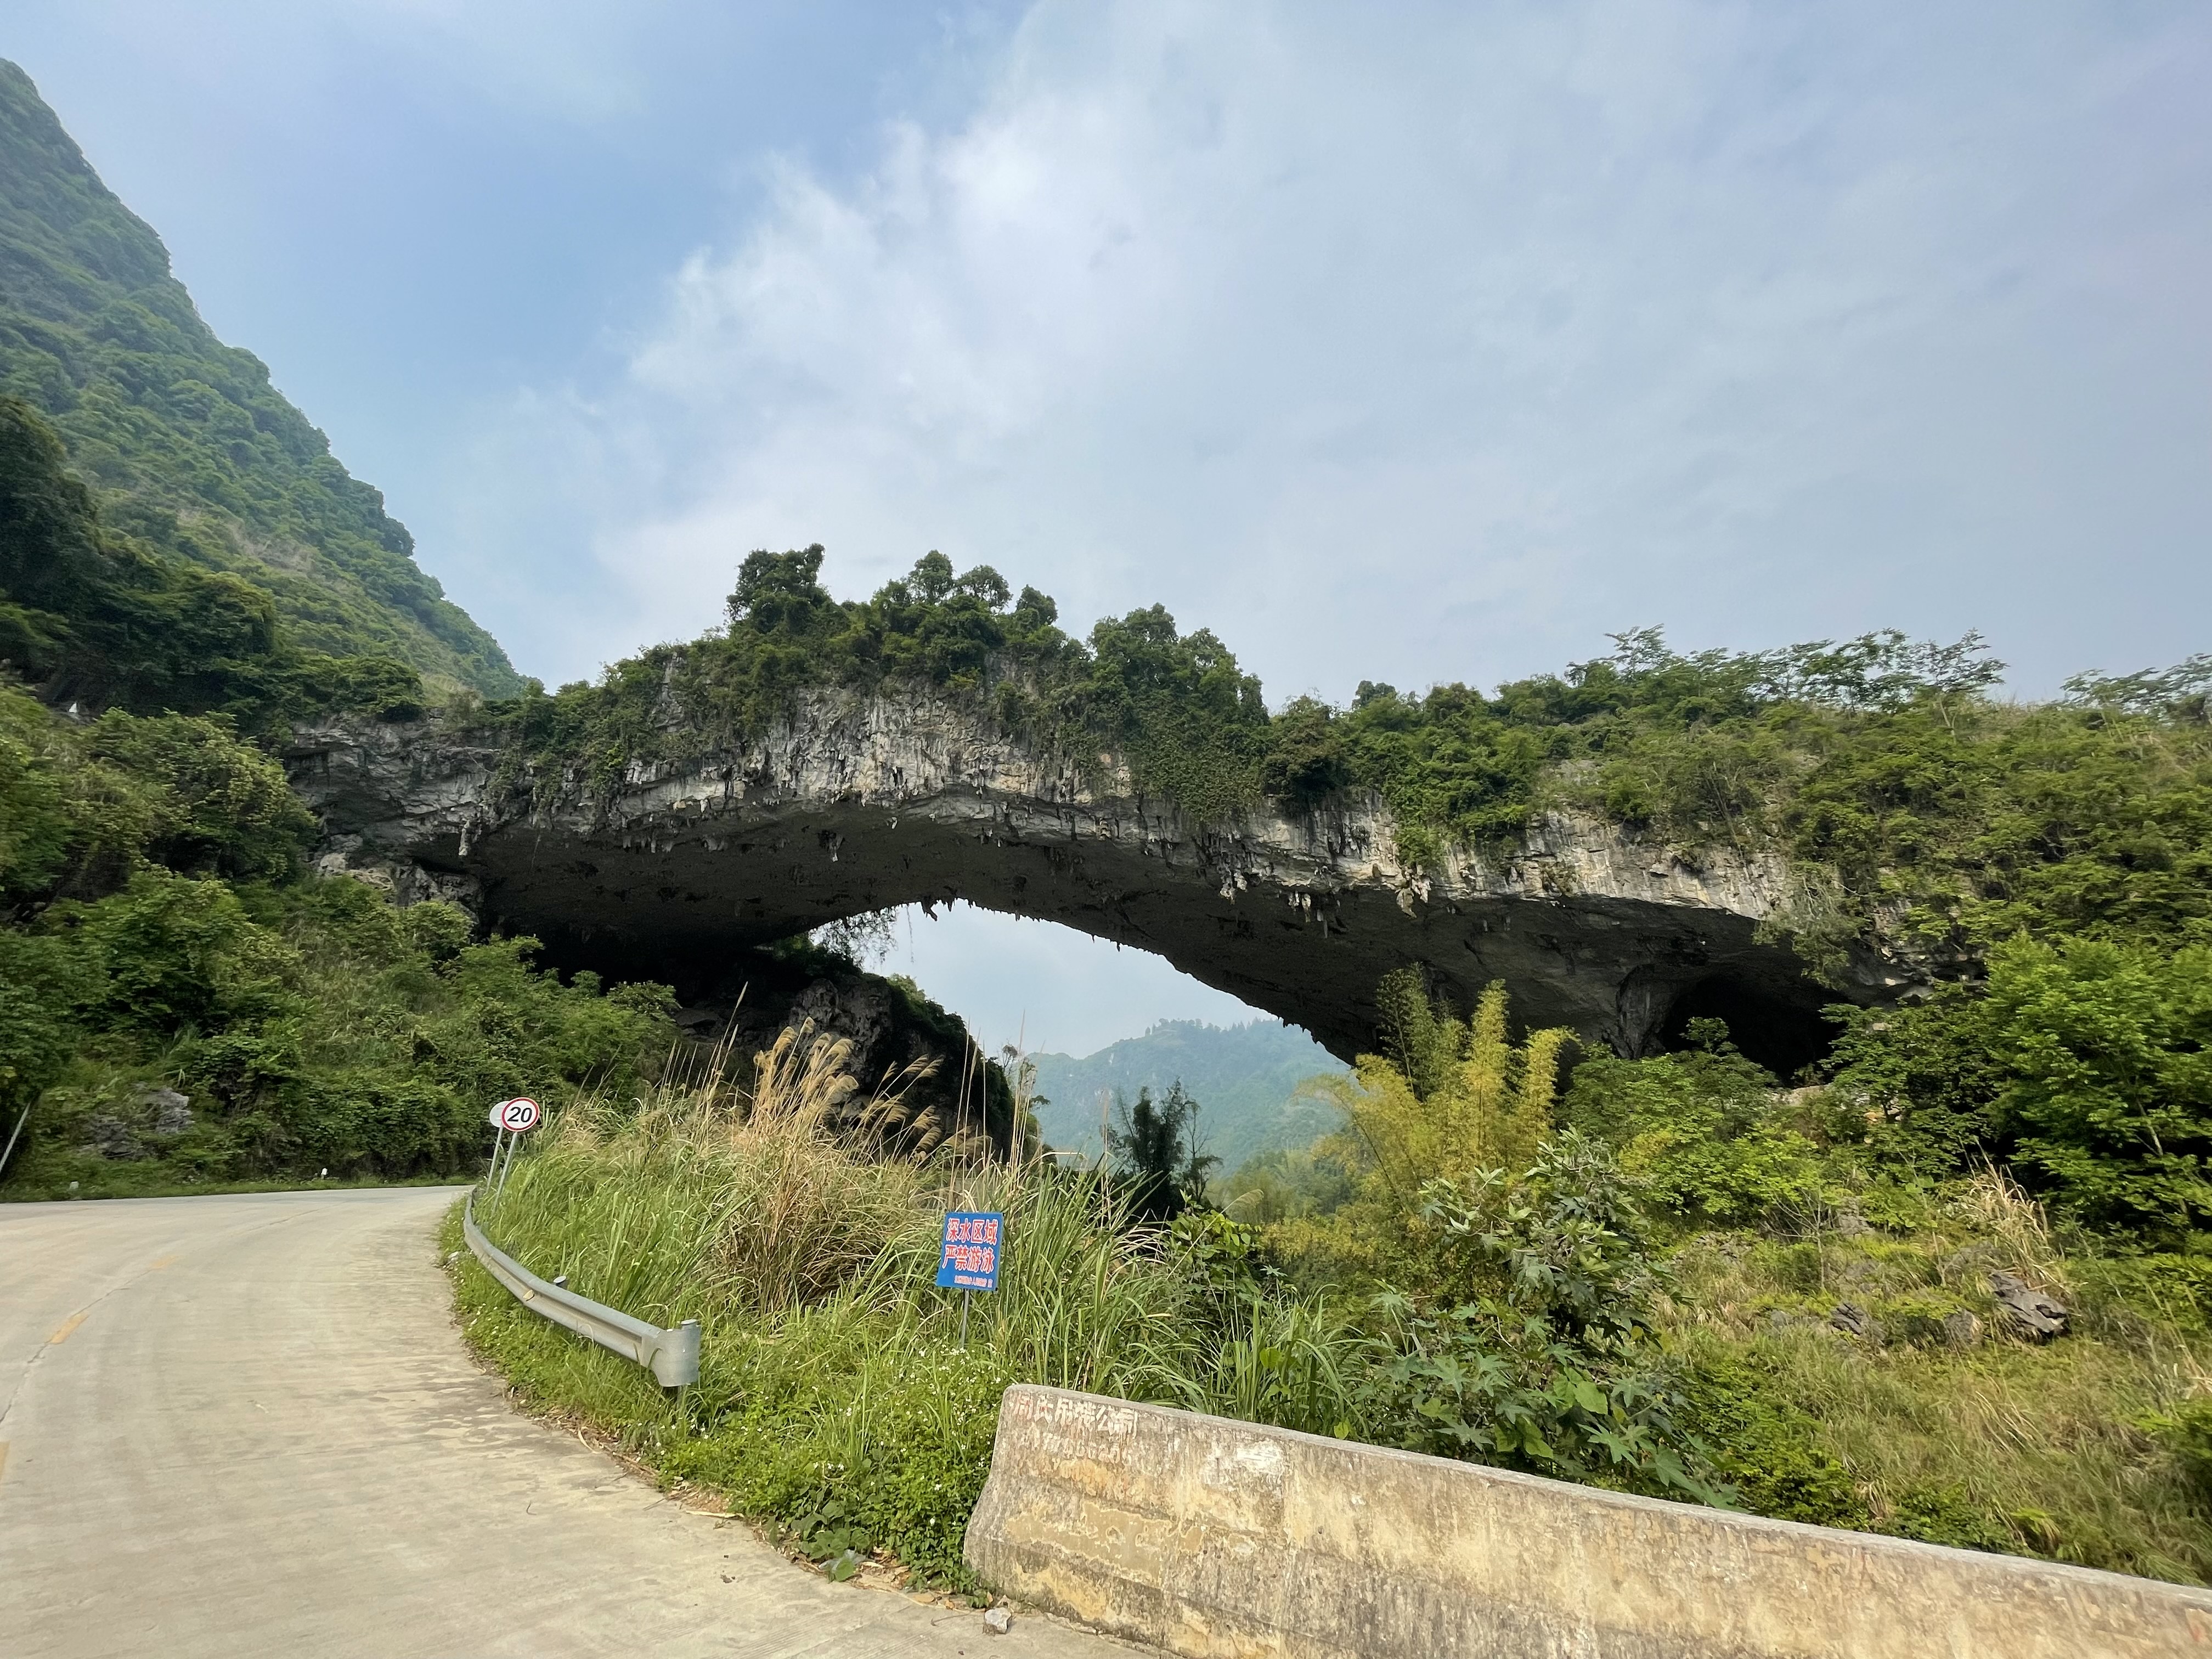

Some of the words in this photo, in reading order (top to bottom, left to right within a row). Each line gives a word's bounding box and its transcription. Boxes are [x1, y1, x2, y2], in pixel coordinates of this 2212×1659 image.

[507, 1107, 533, 1122] 20
[945, 1217, 998, 1246] 深水区域
[941, 1244, 995, 1274] 严禁游泳
